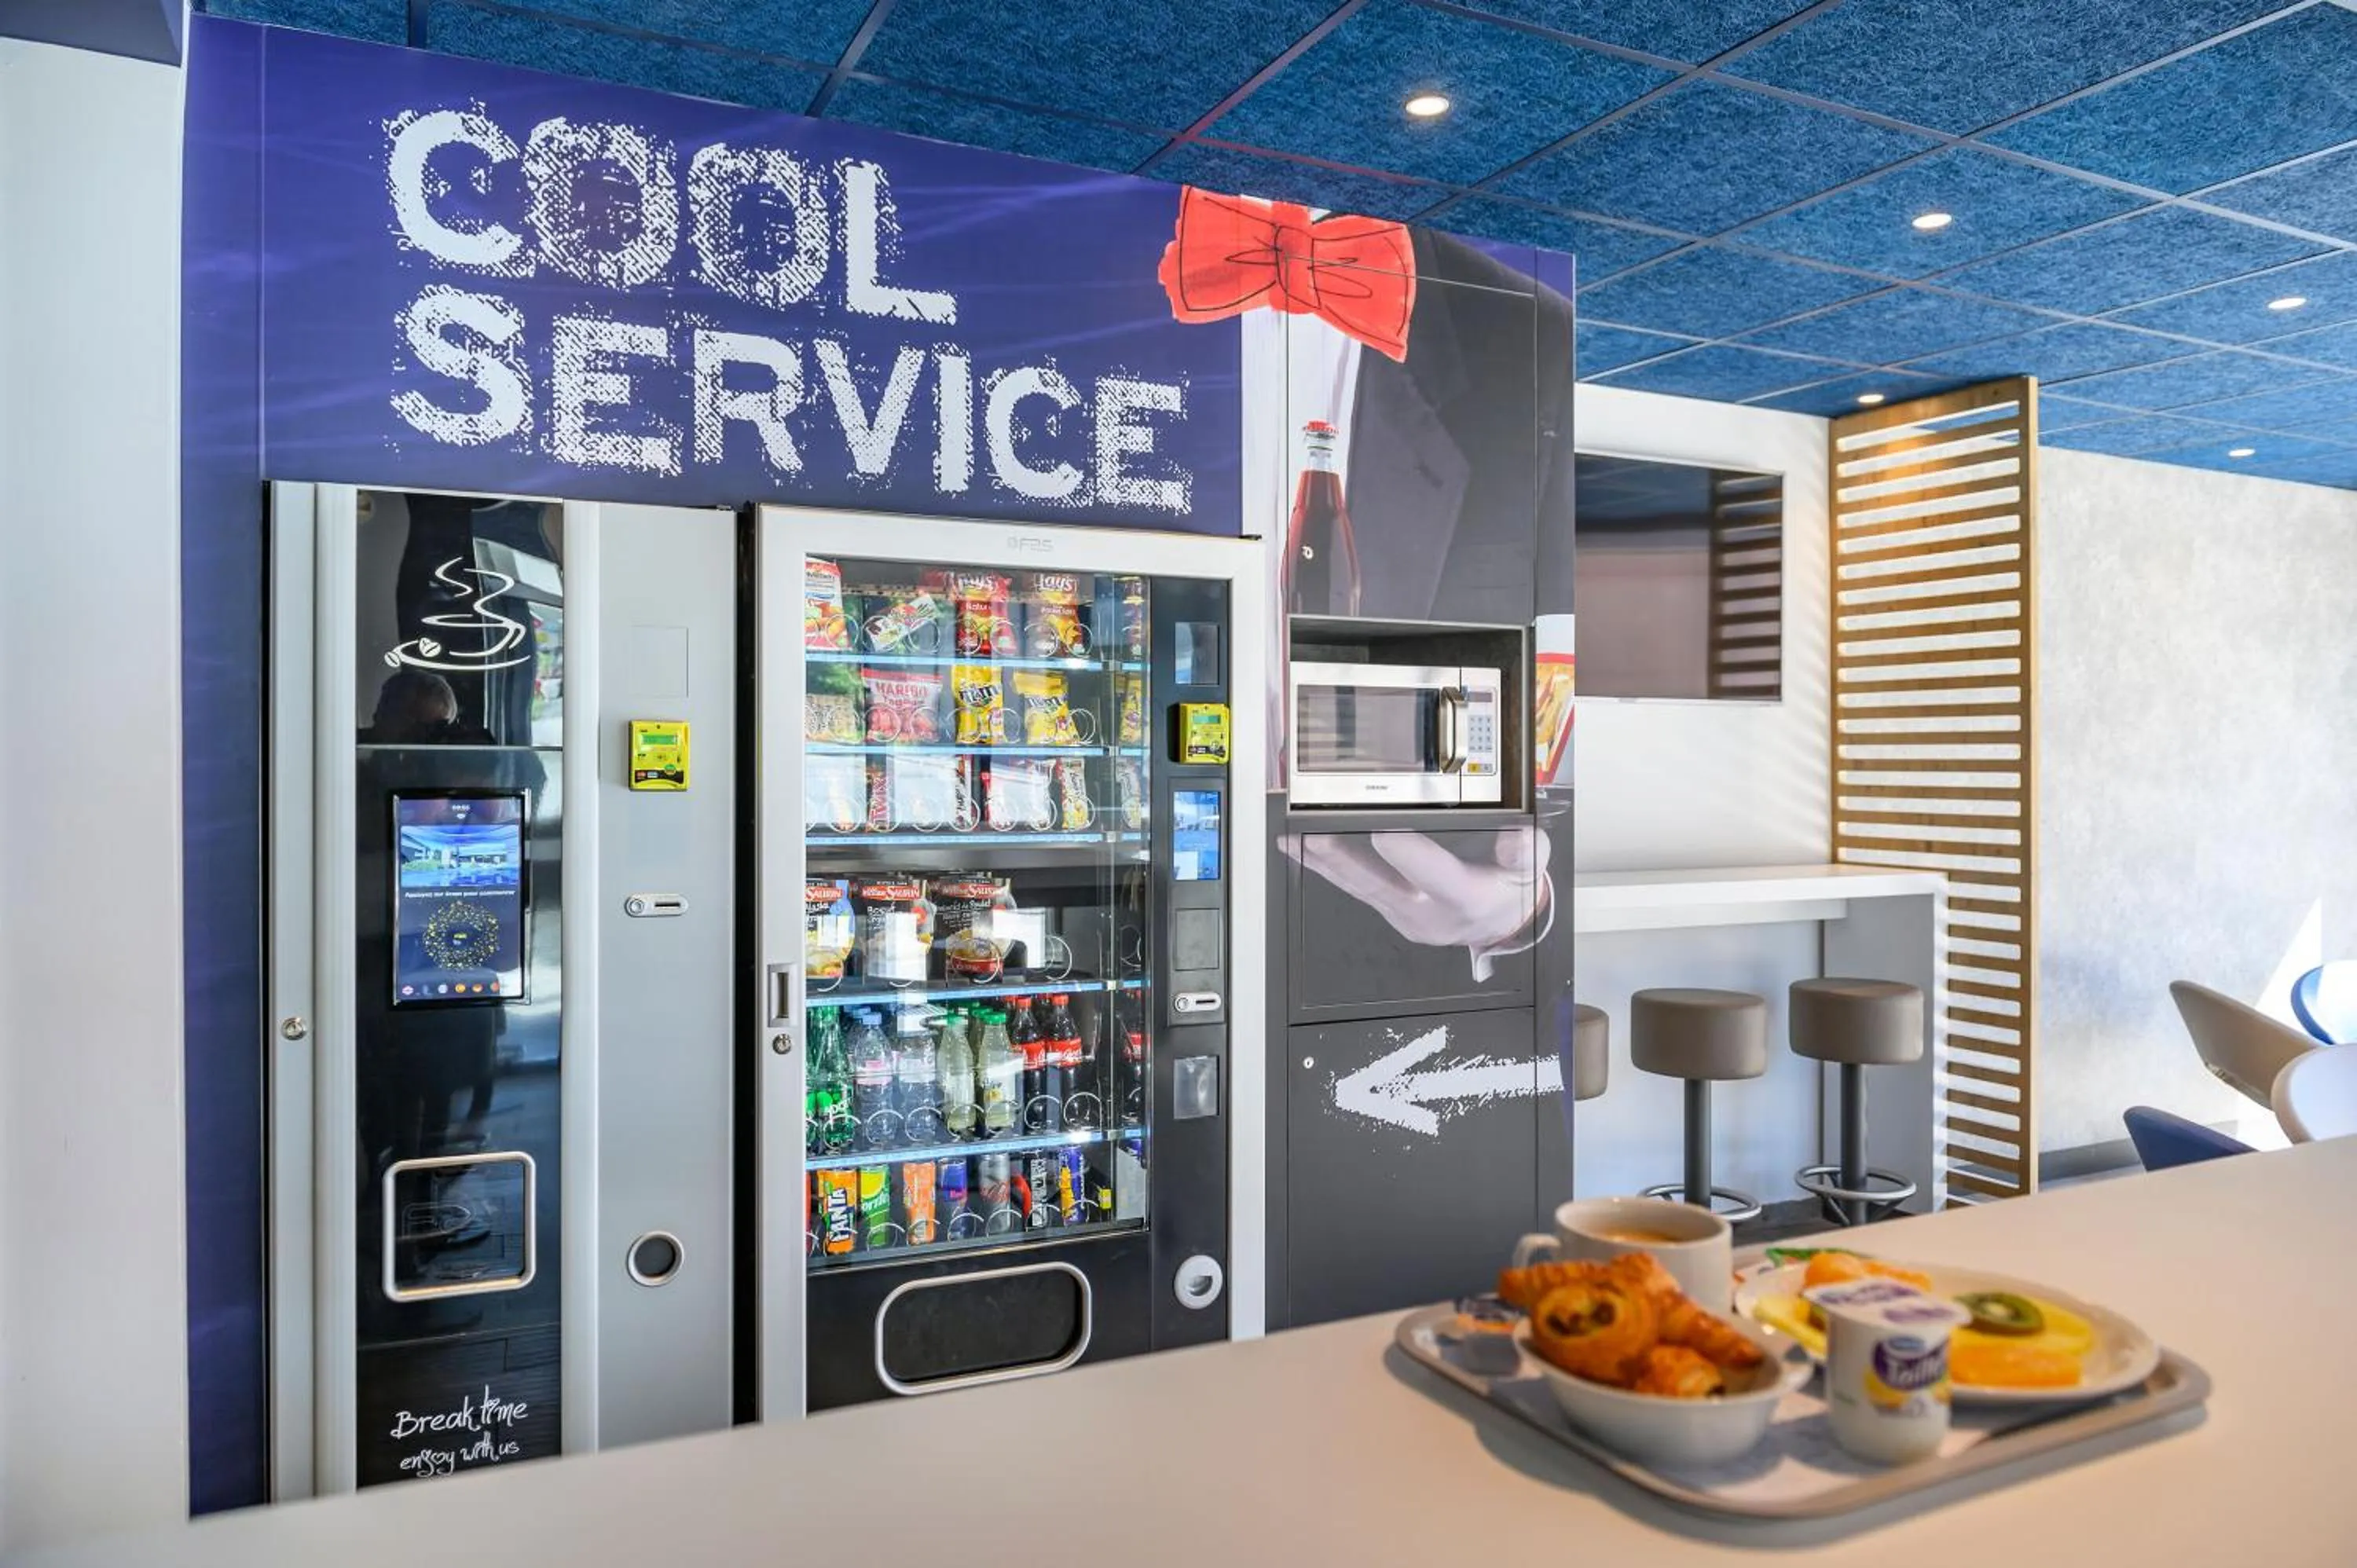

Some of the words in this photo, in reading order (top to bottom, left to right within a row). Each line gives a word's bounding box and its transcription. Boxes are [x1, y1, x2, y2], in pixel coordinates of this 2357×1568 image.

[383, 102, 958, 326] COOL
[390, 283, 1193, 515] SERVICE
[827, 1189, 849, 1241] FANTA
[390, 1395, 481, 1439] Break
[480, 1384, 529, 1427] time
[399, 1449, 455, 1478] enjoy
[460, 1431, 500, 1462] with
[499, 1441, 520, 1455] us
